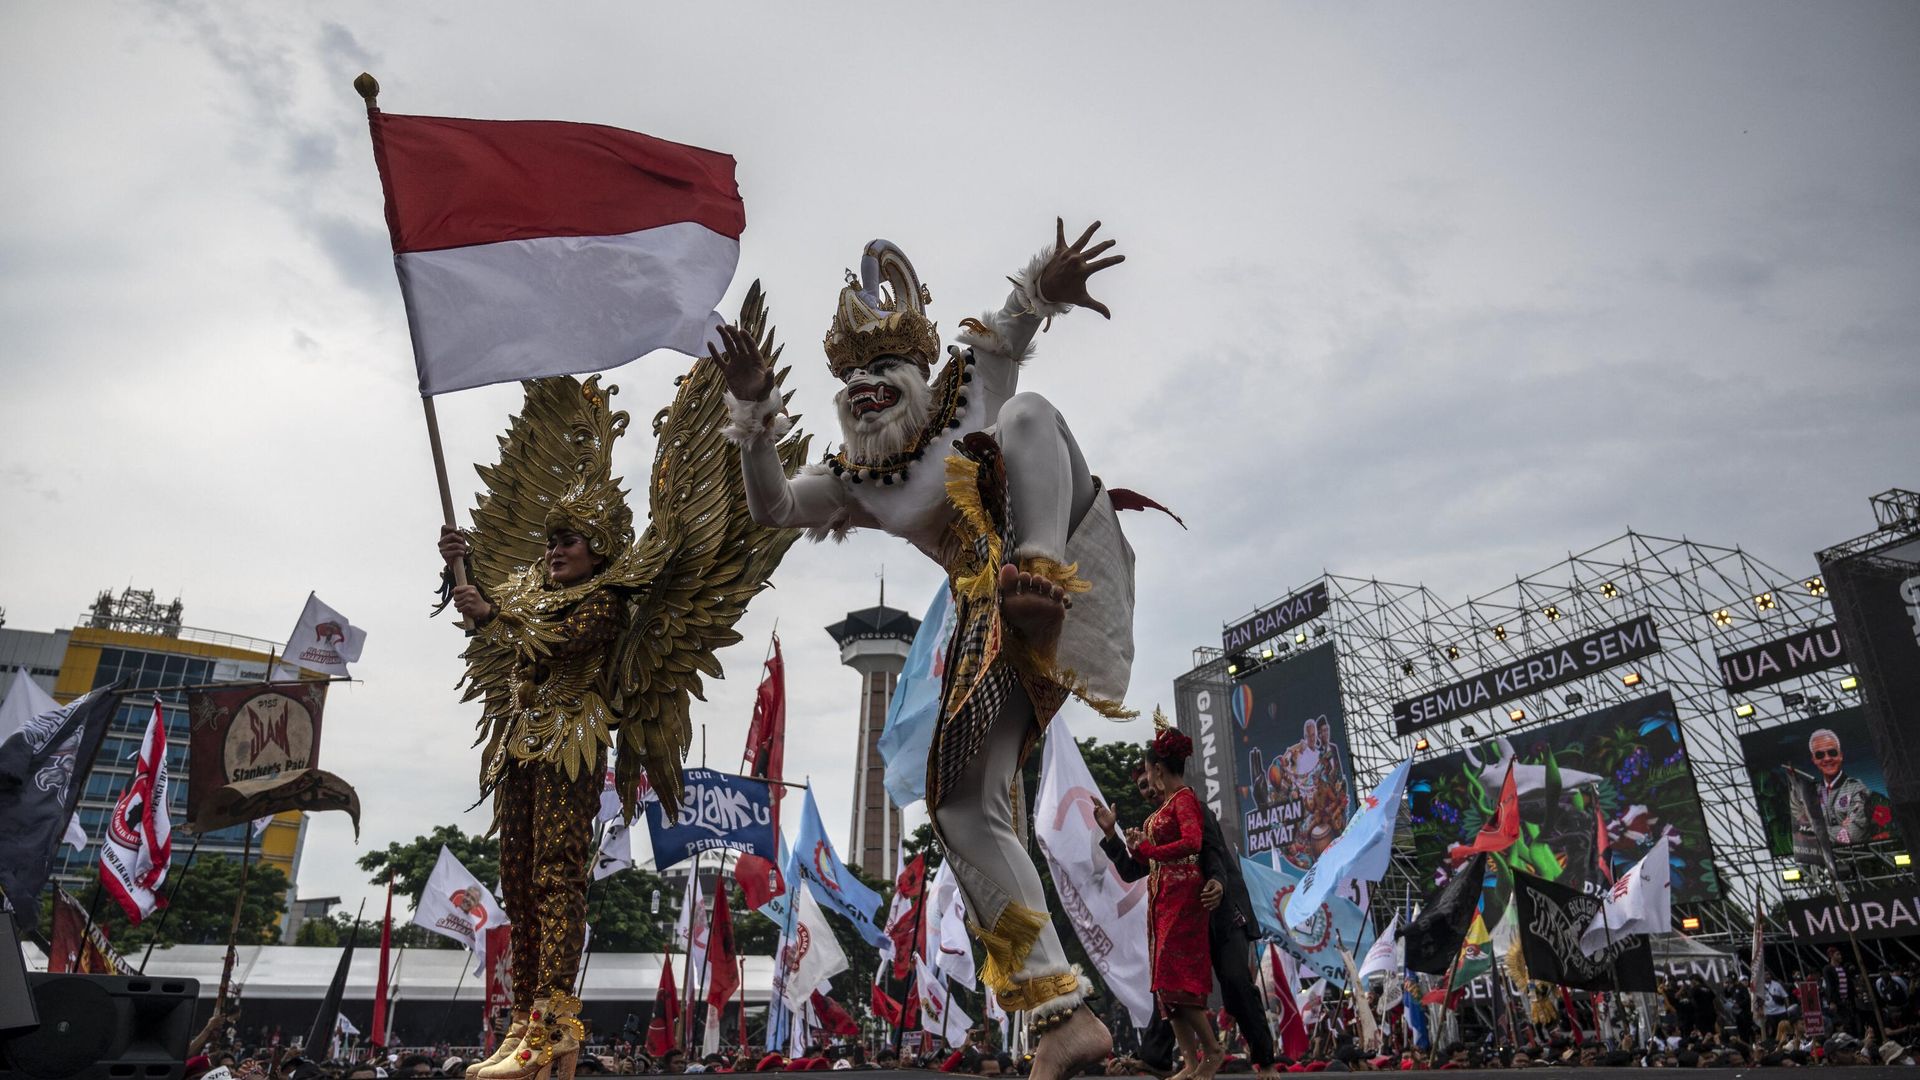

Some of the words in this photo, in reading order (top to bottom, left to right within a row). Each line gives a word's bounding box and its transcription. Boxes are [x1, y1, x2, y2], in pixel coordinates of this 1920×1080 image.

[1255, 592, 1313, 637] RAKYAT
[1786, 629, 1842, 669] MU
[1410, 680, 1491, 724] SEMUA
[1496, 650, 1578, 696] KERJA
[1247, 801, 1302, 831] HAJATAN
[1249, 825, 1295, 851] RAKYAT
